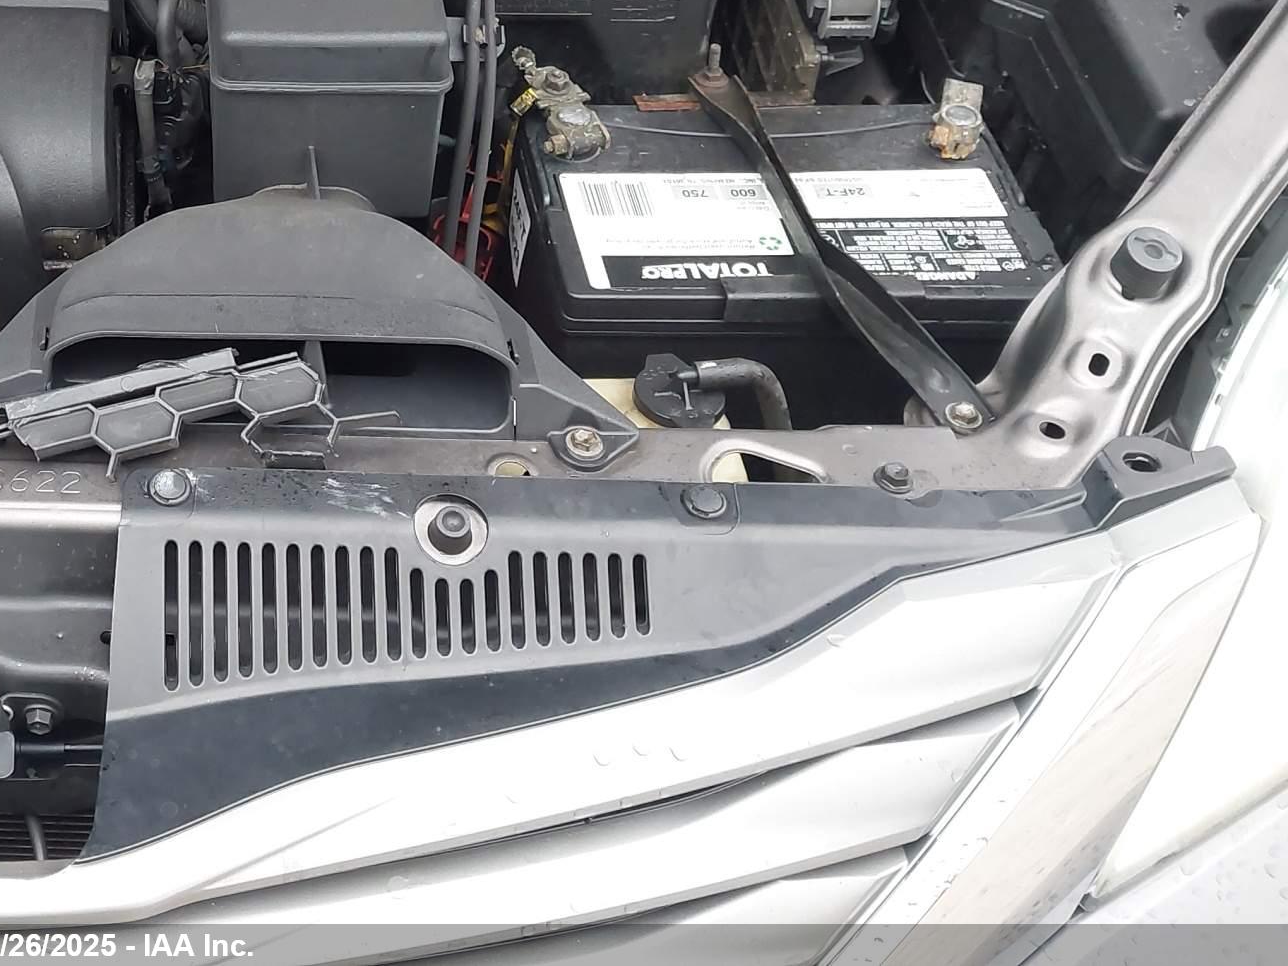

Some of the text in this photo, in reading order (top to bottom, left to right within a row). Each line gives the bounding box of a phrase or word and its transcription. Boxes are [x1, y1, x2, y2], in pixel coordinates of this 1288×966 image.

[682, 188, 757, 198] 600 750
[825, 187, 867, 197] 24F-T
[641, 261, 774, 281] TOTALPRO
